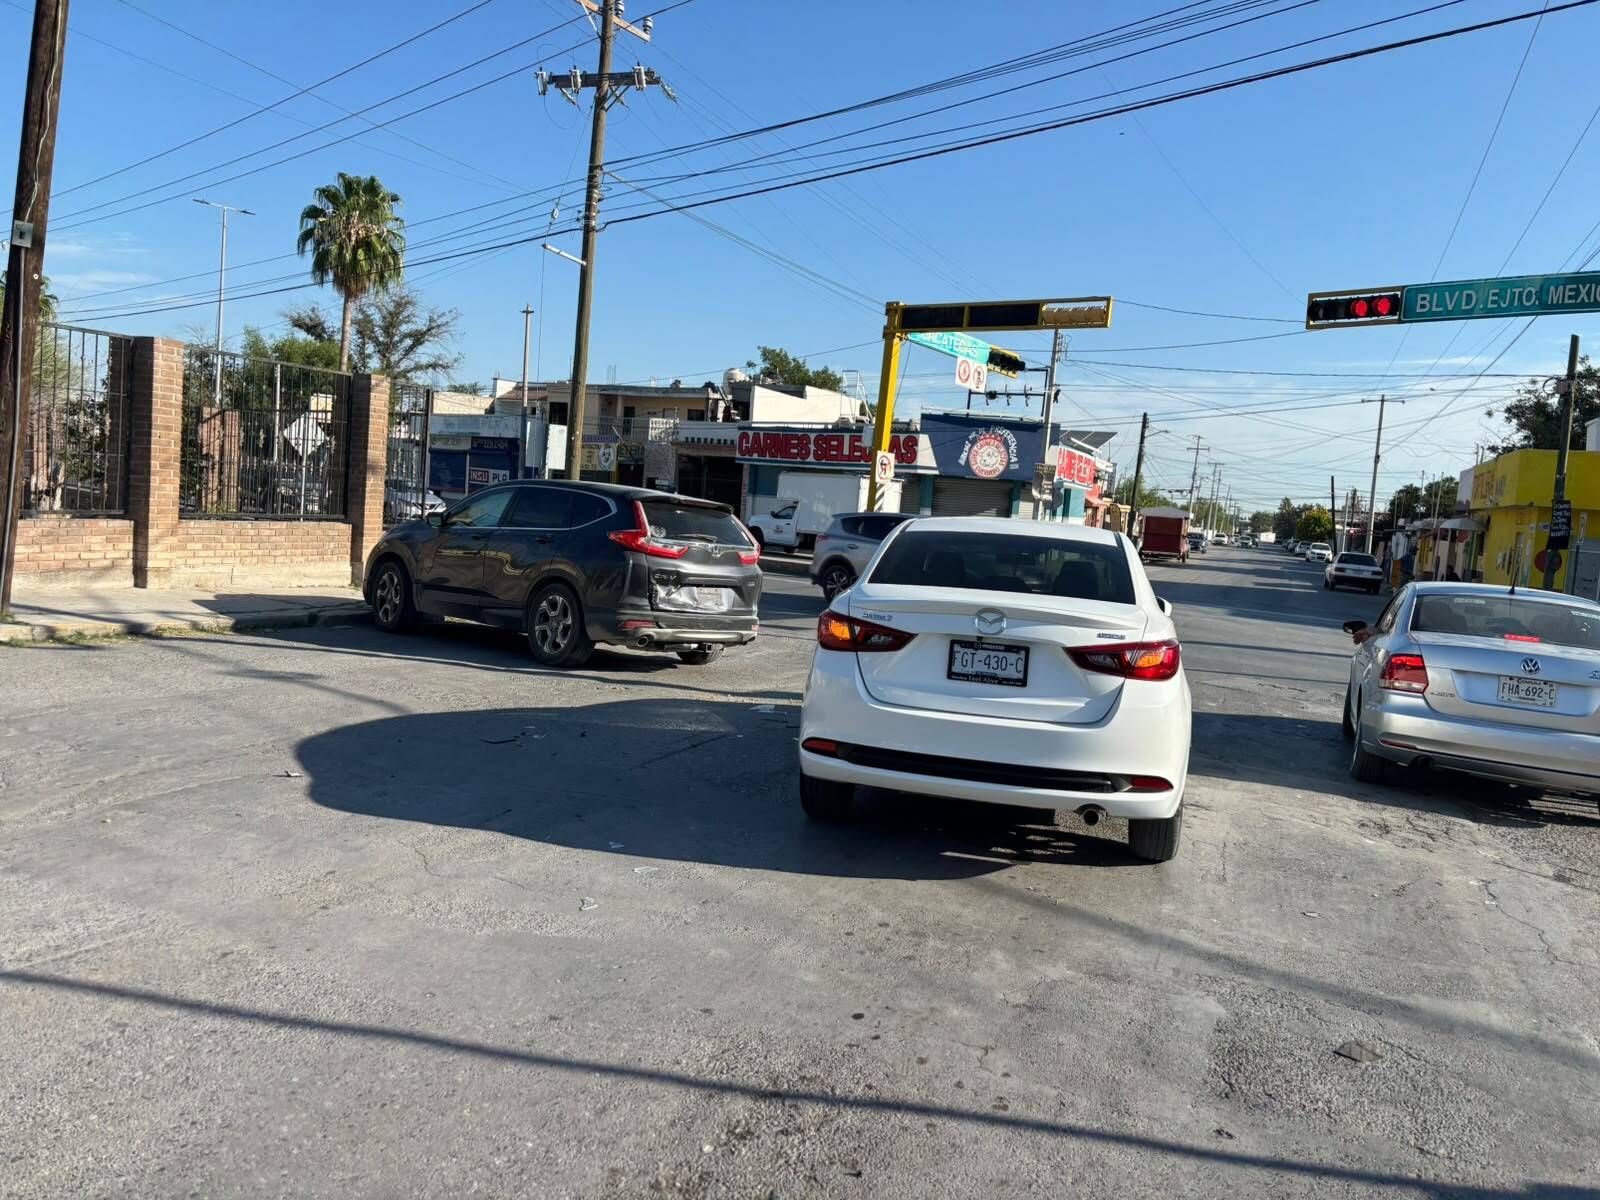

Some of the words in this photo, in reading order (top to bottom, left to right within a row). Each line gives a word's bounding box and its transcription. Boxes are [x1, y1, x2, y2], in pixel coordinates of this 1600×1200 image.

[738, 432, 812, 461] CARNES
[813, 434, 918, 464] SELEAS
[952, 650, 1024, 674] FGT-430-C
[1501, 682, 1555, 700] FHA-692-C
